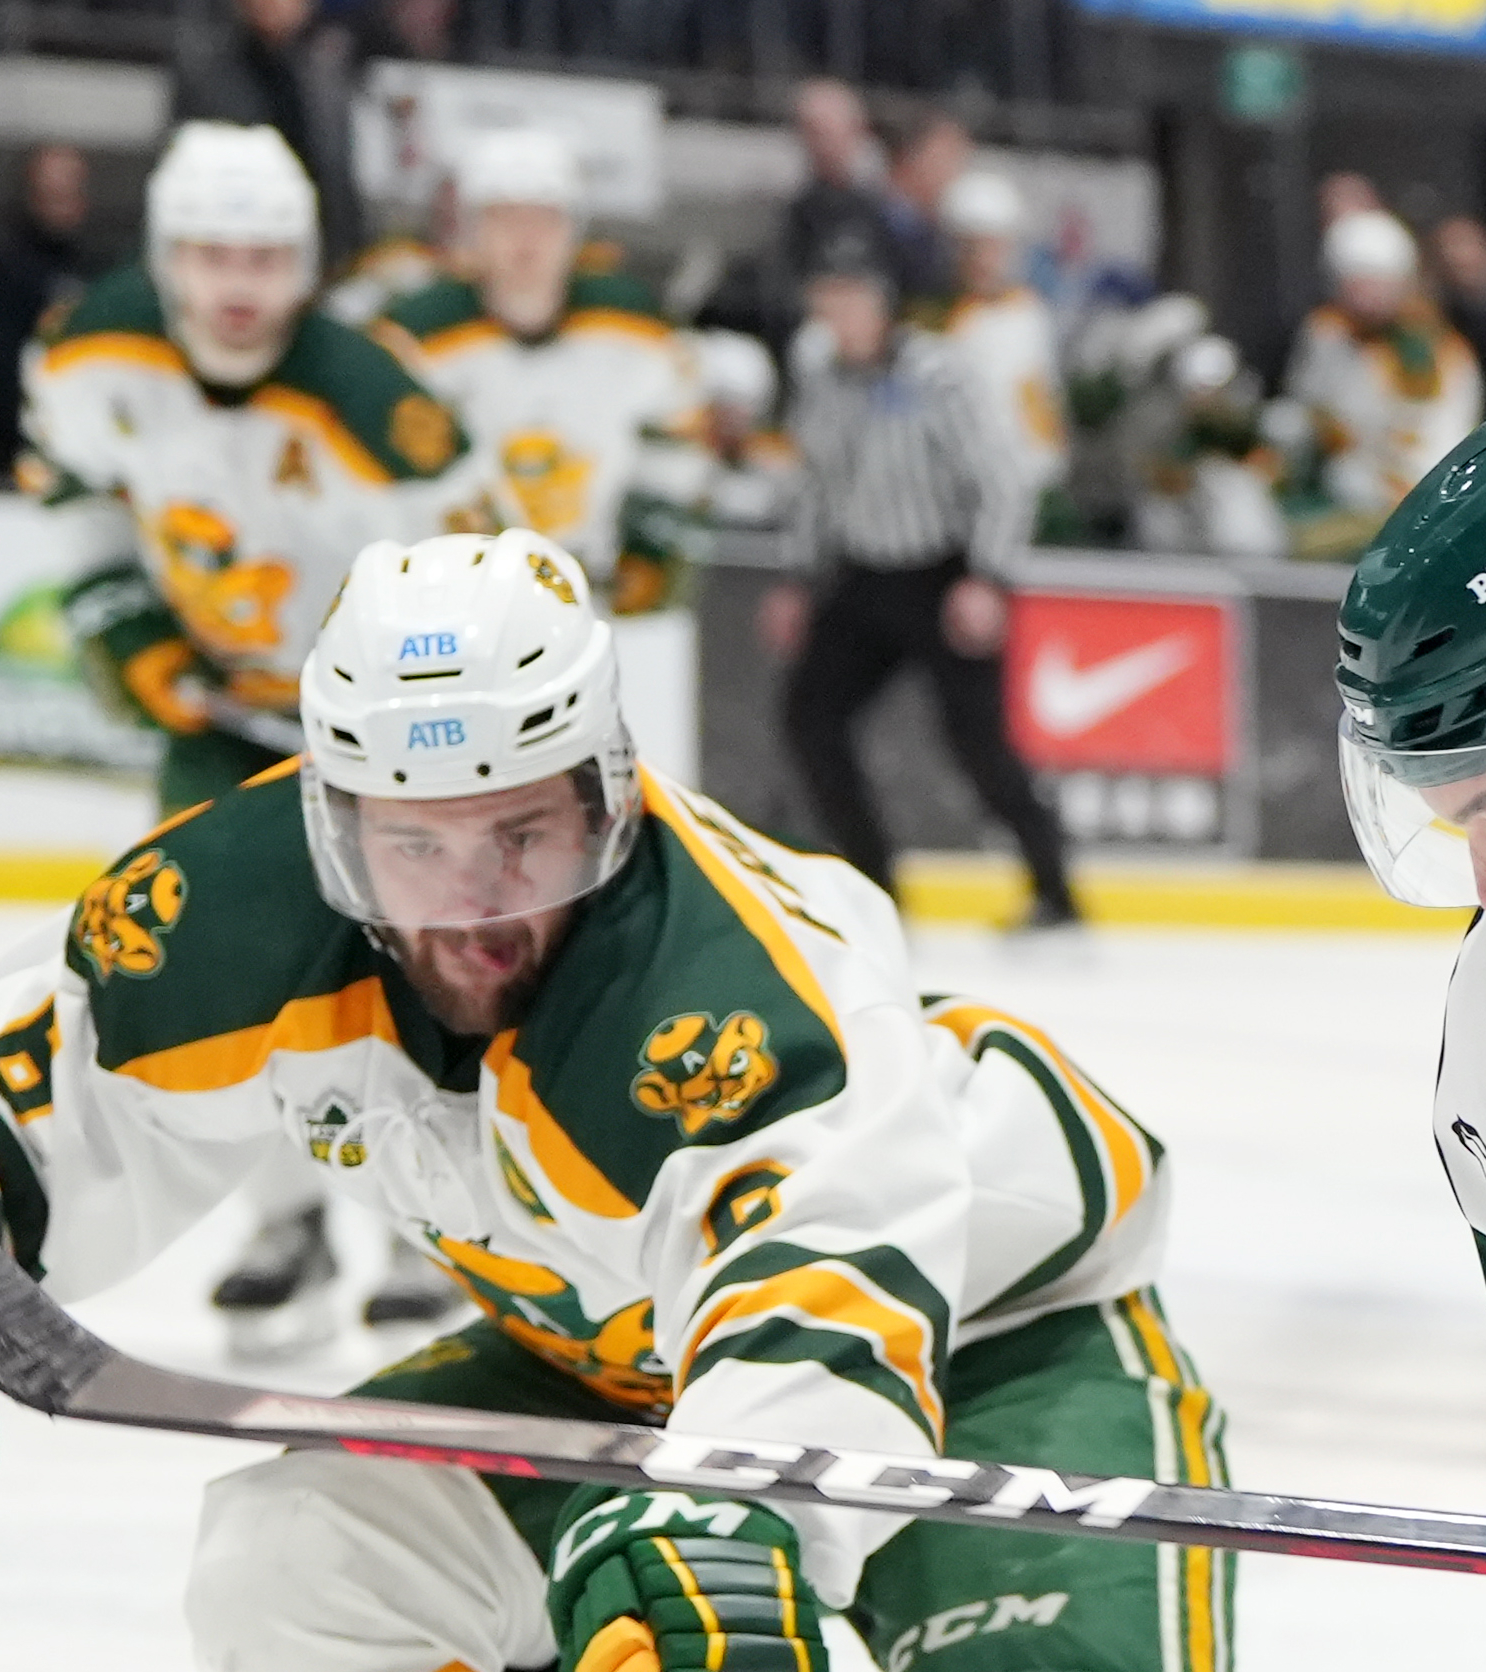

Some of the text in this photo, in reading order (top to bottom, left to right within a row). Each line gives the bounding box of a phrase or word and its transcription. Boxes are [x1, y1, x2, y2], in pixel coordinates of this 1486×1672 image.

[399, 632, 459, 660] ATB
[408, 719, 466, 749] ATB
[636, 1430, 1156, 1530] CCM
